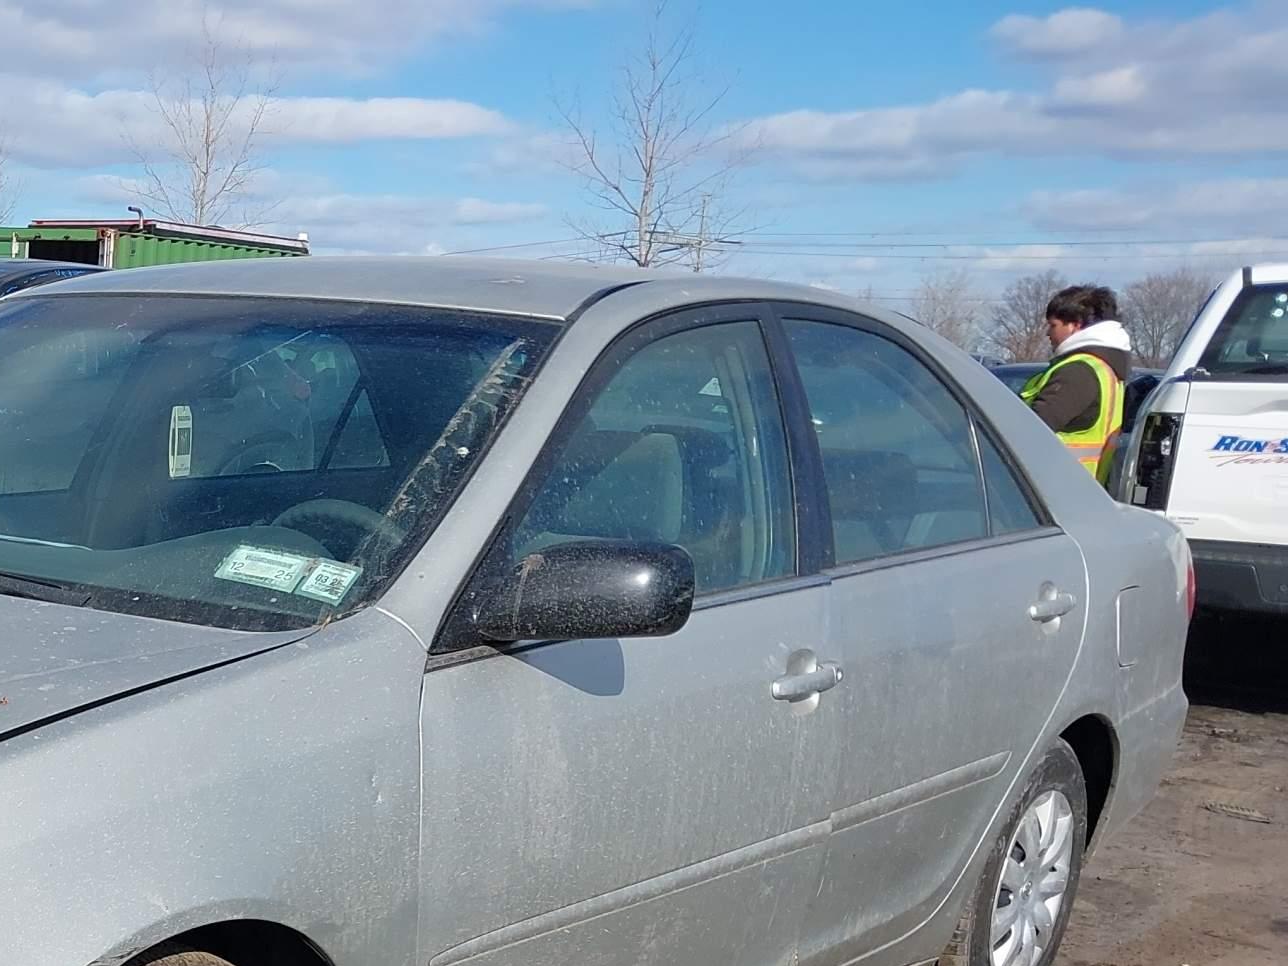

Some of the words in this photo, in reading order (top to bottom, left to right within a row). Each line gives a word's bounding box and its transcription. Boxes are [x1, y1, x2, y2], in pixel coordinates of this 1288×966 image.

[229, 561, 245, 572] 12
[274, 569, 293, 582] 25
[315, 573, 330, 585] 03
